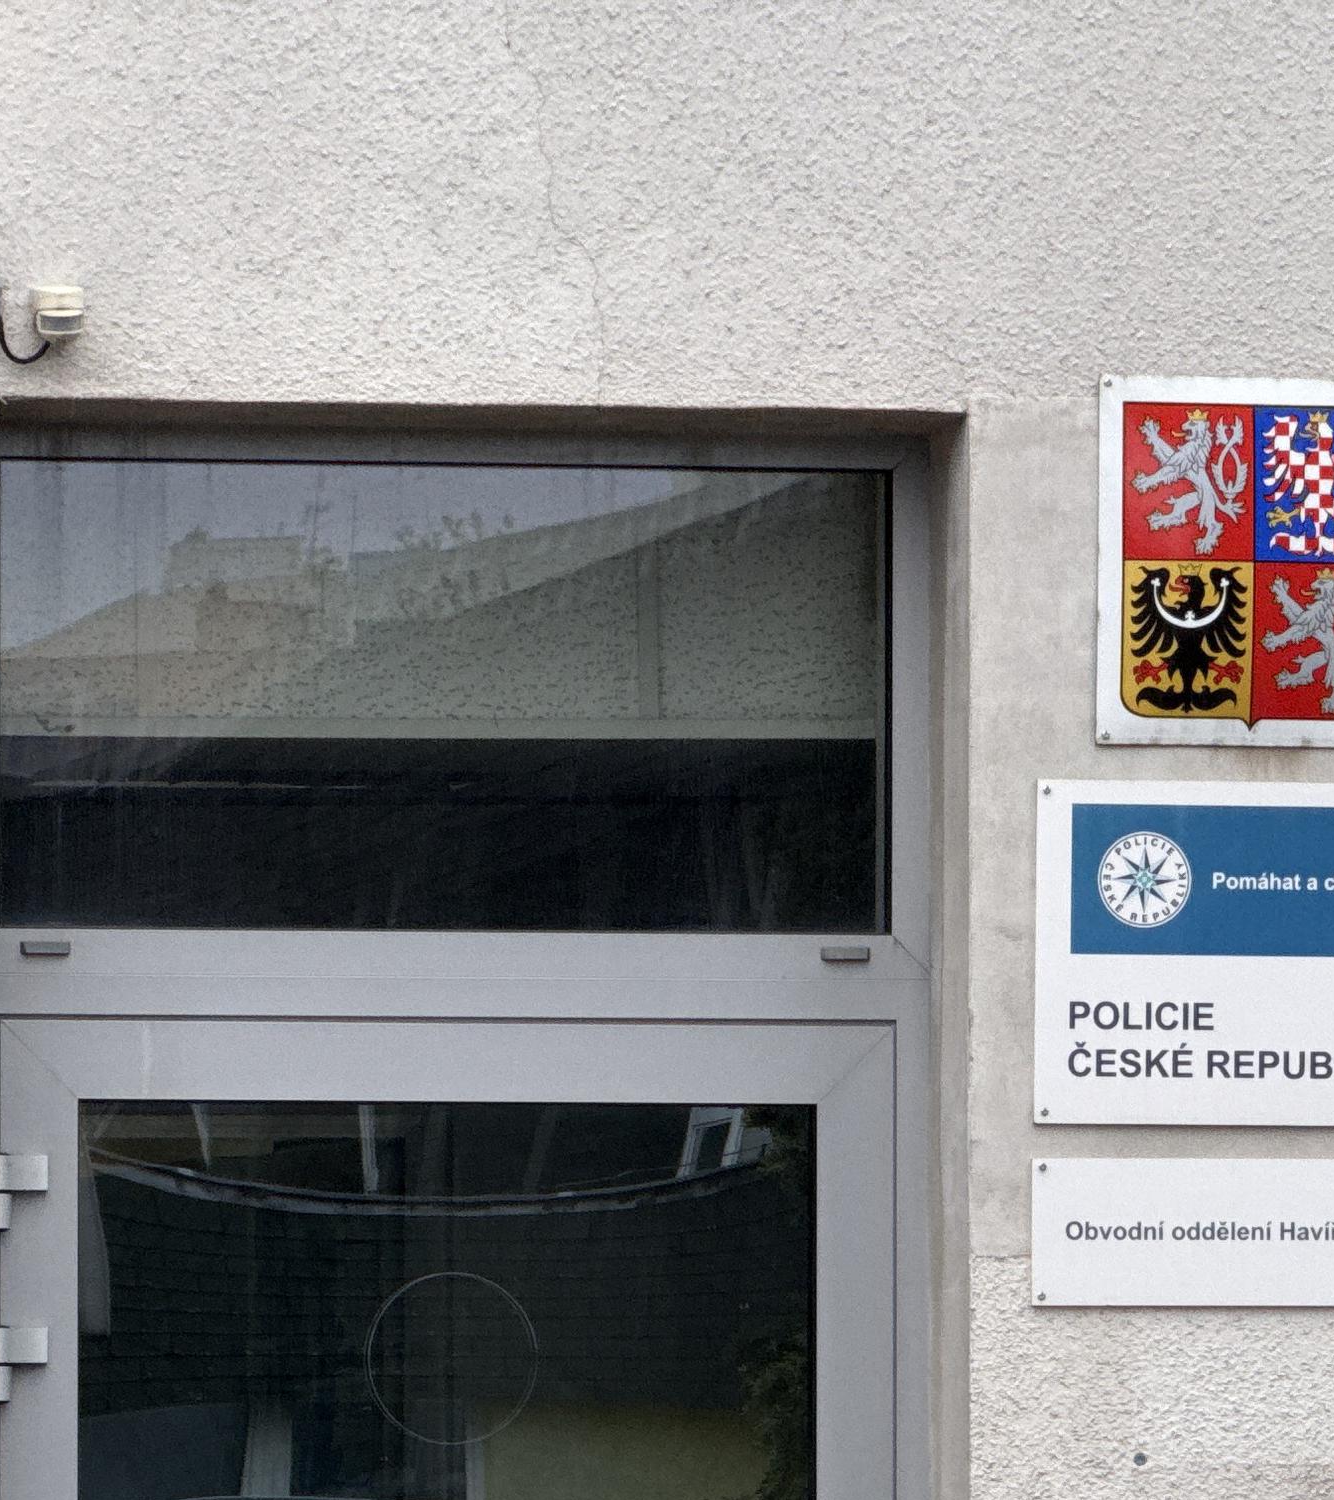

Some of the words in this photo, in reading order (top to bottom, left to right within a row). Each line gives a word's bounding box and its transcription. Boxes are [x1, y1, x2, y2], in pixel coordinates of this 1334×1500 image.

[1114, 836, 1176, 857] POLICIE
[1130, 862, 1187, 923] REPUBLIKY
[1212, 872, 1301, 891] Pomáhat
[1306, 876, 1318, 891] a
[1069, 1000, 1215, 1031] POLICIE
[1067, 1041, 1194, 1079] ČESKÉ
[1065, 1220, 1165, 1242] Obvodní
[1171, 1220, 1272, 1242] oddělení
